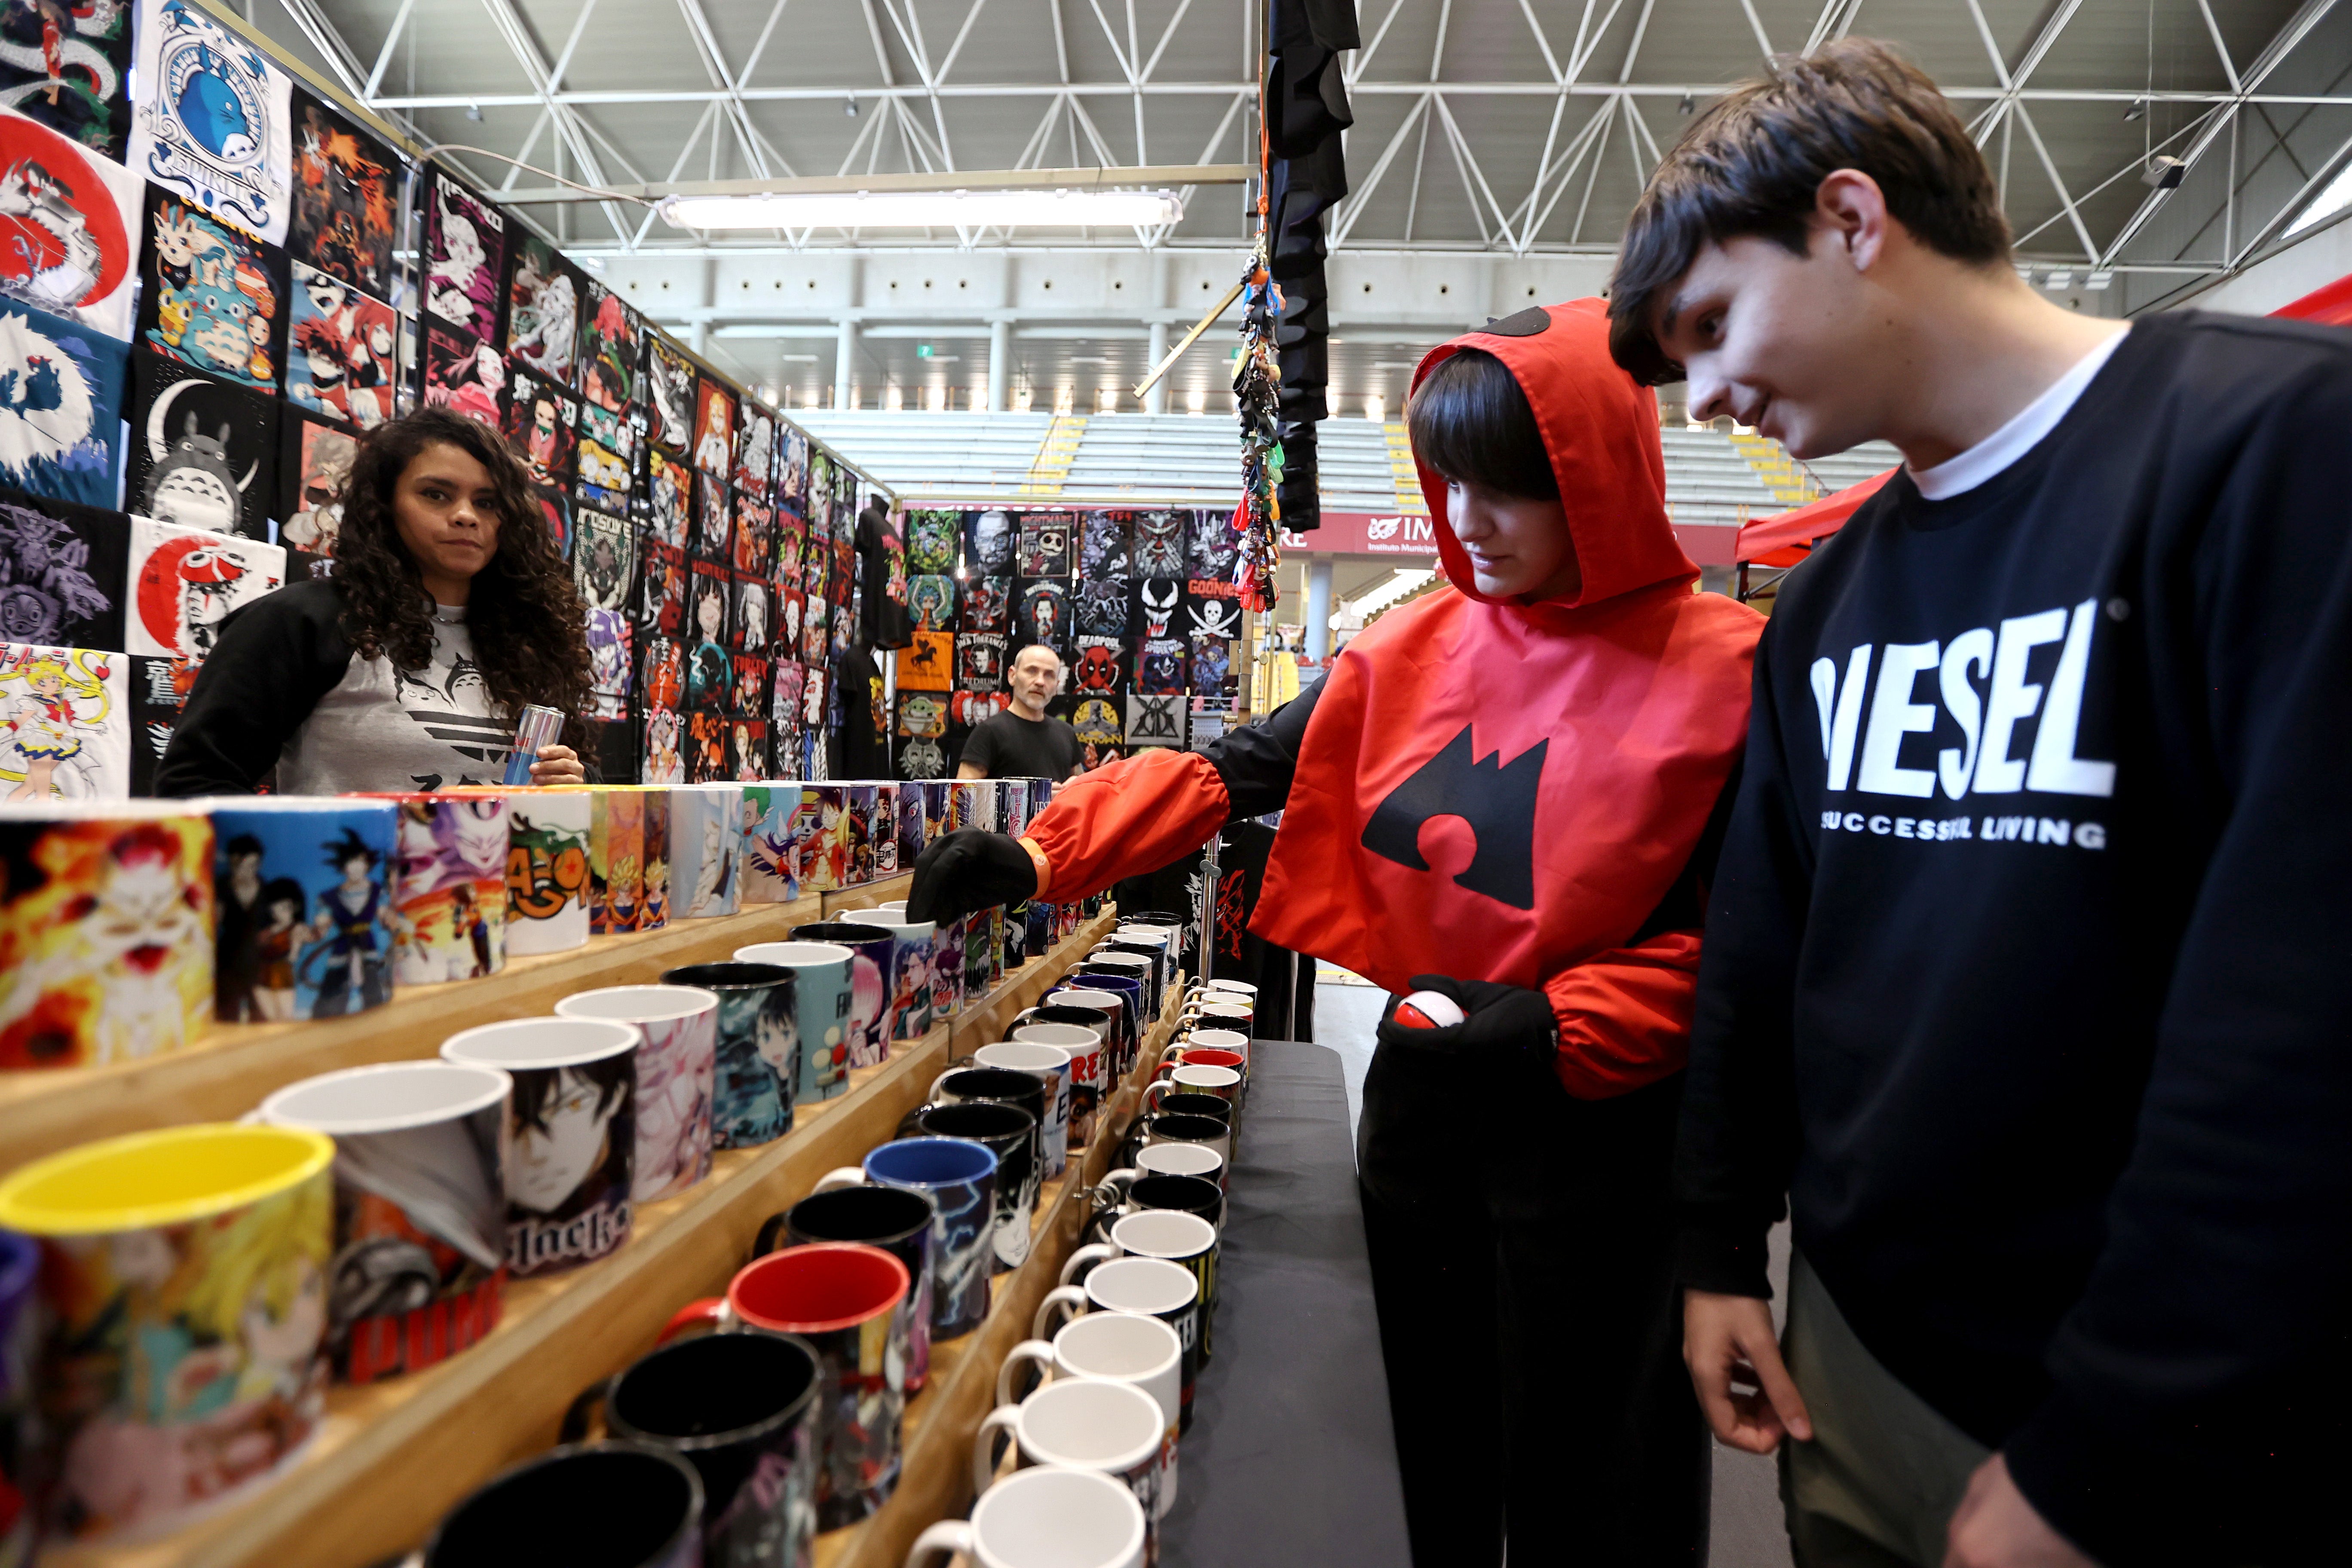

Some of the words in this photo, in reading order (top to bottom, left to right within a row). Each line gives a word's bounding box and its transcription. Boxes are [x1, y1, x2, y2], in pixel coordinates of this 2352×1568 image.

[1368, 542, 1400, 552] Instituto
[1401, 543, 1438, 554] Municipal
[1980, 815, 2106, 850] LIVING
